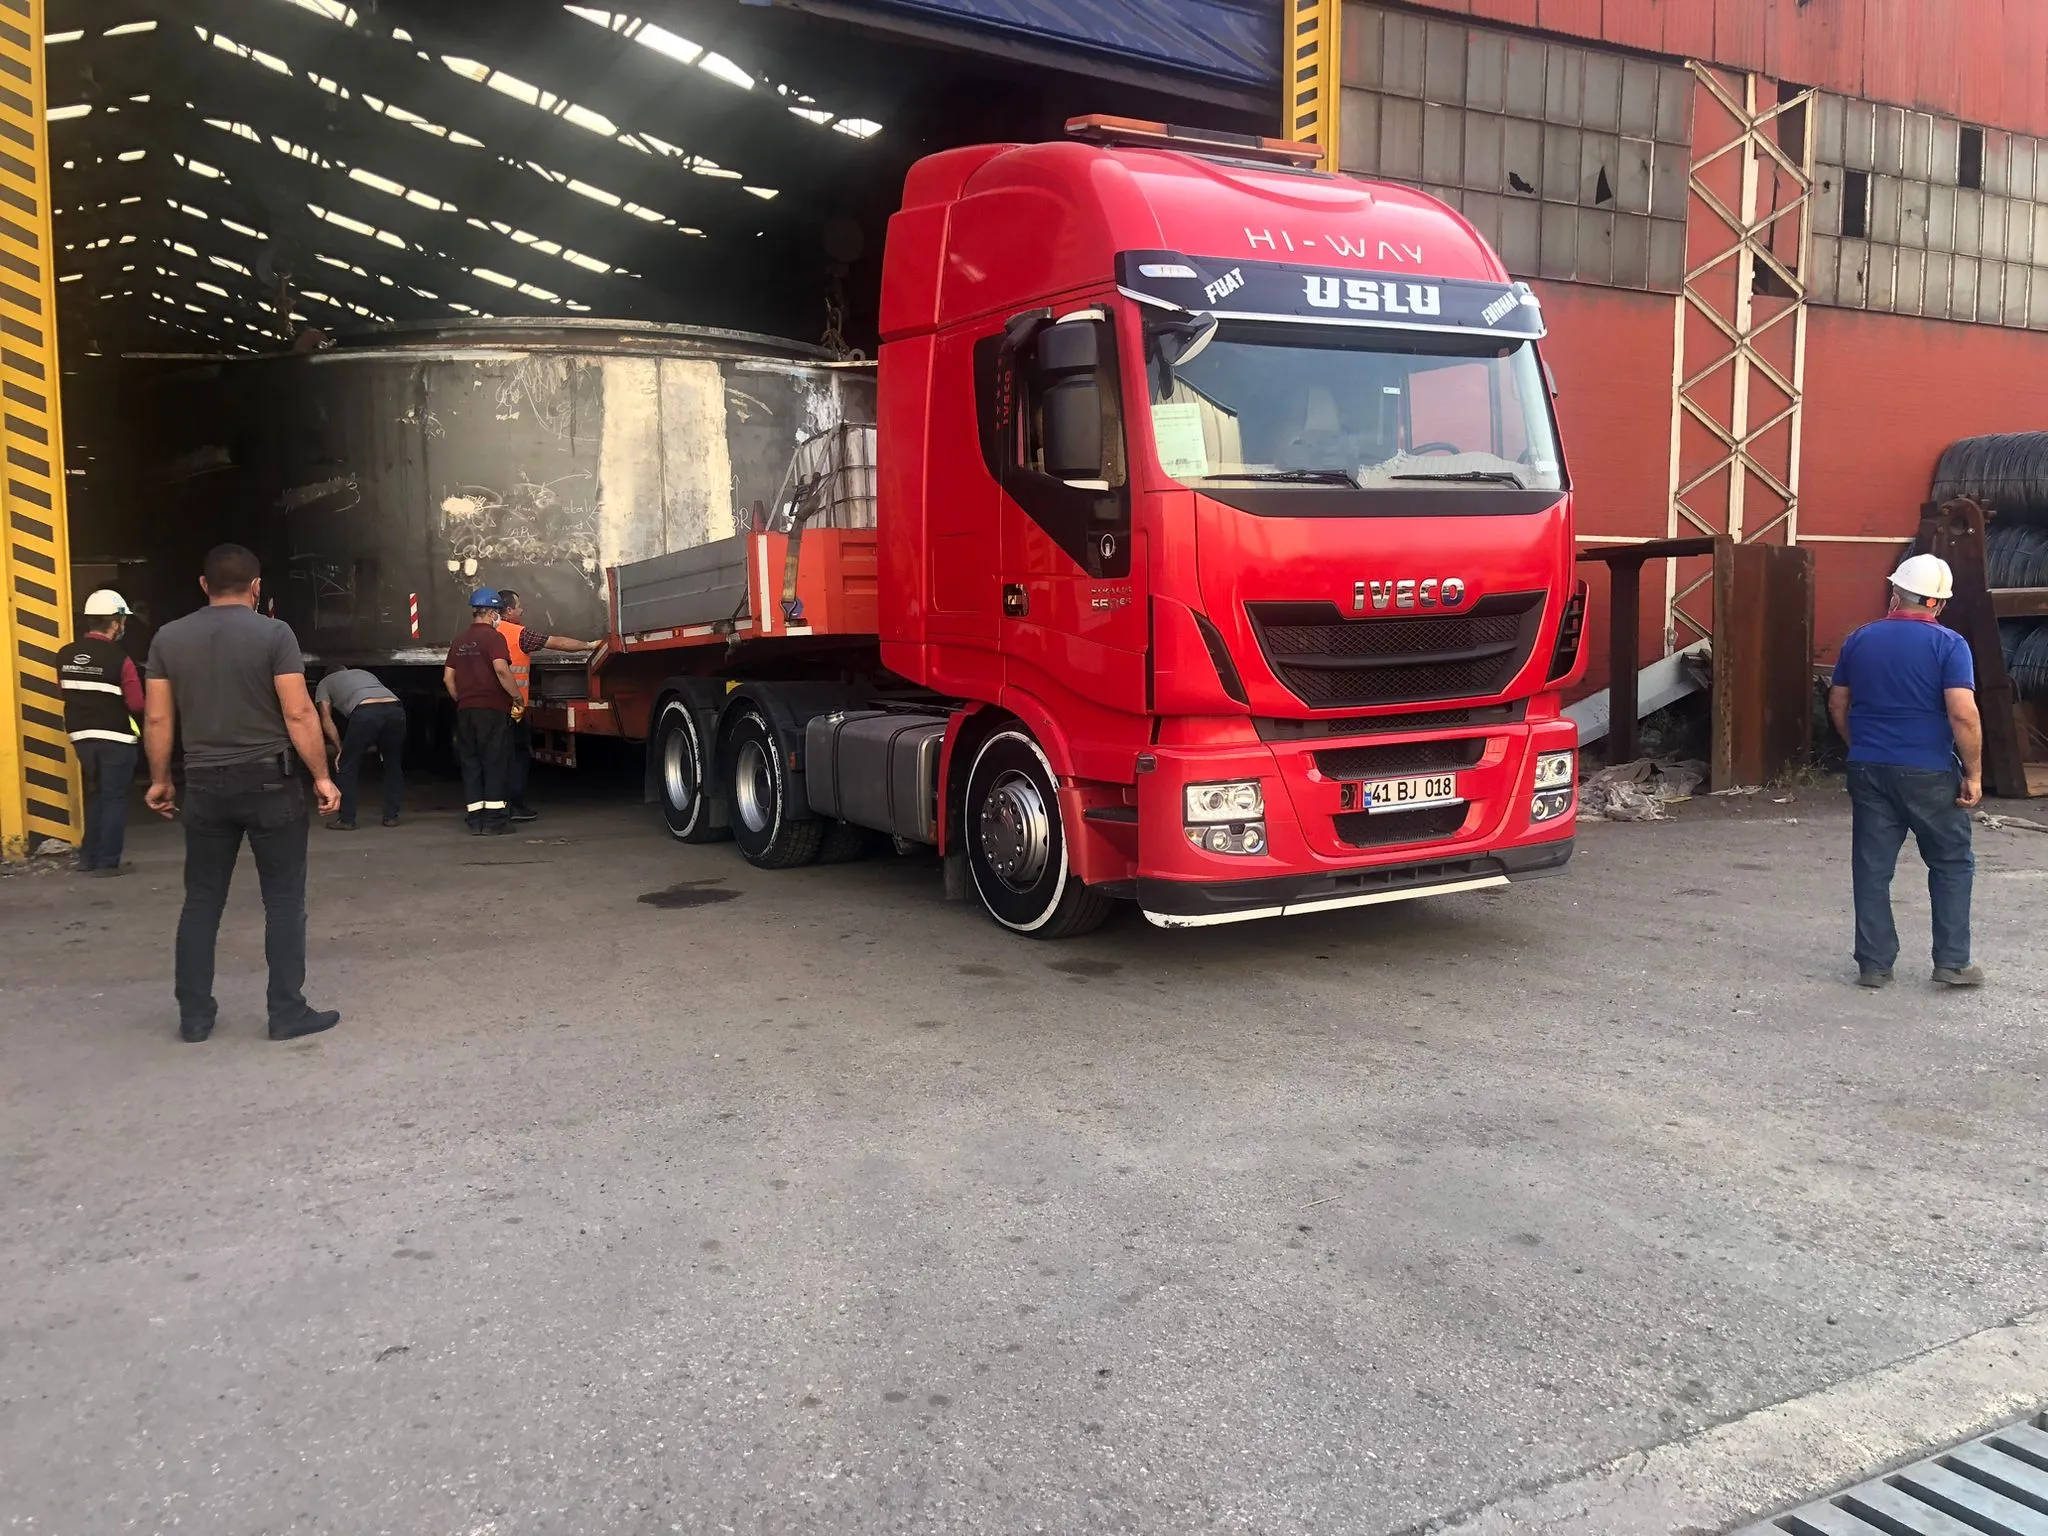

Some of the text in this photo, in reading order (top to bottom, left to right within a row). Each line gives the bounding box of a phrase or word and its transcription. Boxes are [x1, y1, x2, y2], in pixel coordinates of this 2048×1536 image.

[1243, 226, 1423, 265] HI-WAY
[1203, 266, 1246, 305] FUAT
[1301, 274, 1441, 316] USLU
[1002, 369, 1013, 425] IVECO
[1353, 577, 1465, 610] IVECO
[1372, 777, 1452, 803] 41 BJ 018
